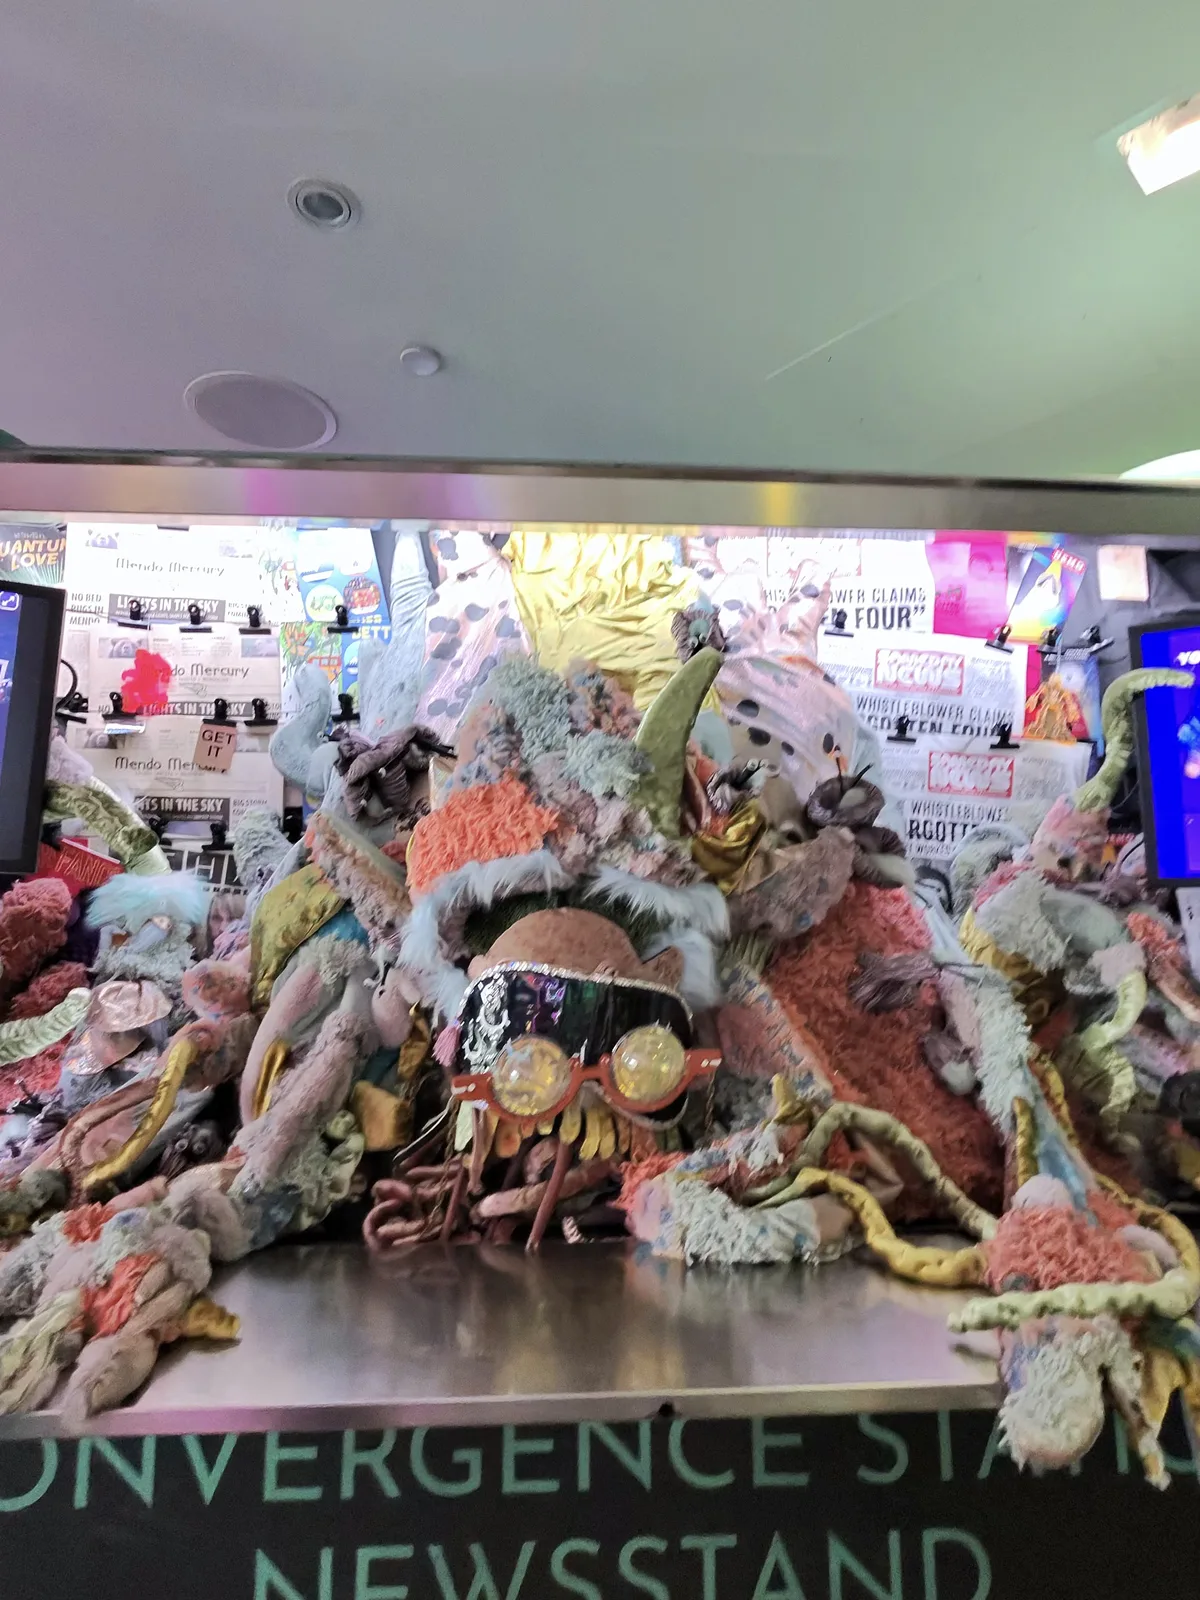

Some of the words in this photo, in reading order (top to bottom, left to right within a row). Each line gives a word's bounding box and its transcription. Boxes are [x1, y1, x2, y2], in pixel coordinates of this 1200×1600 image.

[11, 552, 59, 571] LOVE
[116, 557, 164, 573] Mendo
[168, 561, 226, 577] Mercury
[71, 592, 84, 602] NO
[872, 587, 927, 604] CLAIMS
[116, 595, 158, 612] LITS
[159, 598, 172, 612] IN
[196, 599, 220, 614] SKY
[190, 662, 251, 678] Mercury
[183, 702, 197, 715] IN
[856, 694, 965, 722] WHISTLEBLOWER
[202, 729, 236, 745] GET
[207, 745, 223, 758] IT
[114, 756, 162, 771] Mendo
[160, 797, 174, 812] IN
[175, 797, 200, 813] THE
[200, 798, 224, 813] SKY
[911, 799, 1012, 823] WHISTLEBLOWE
[253, 1525, 991, 1600] NEWSSTAND
